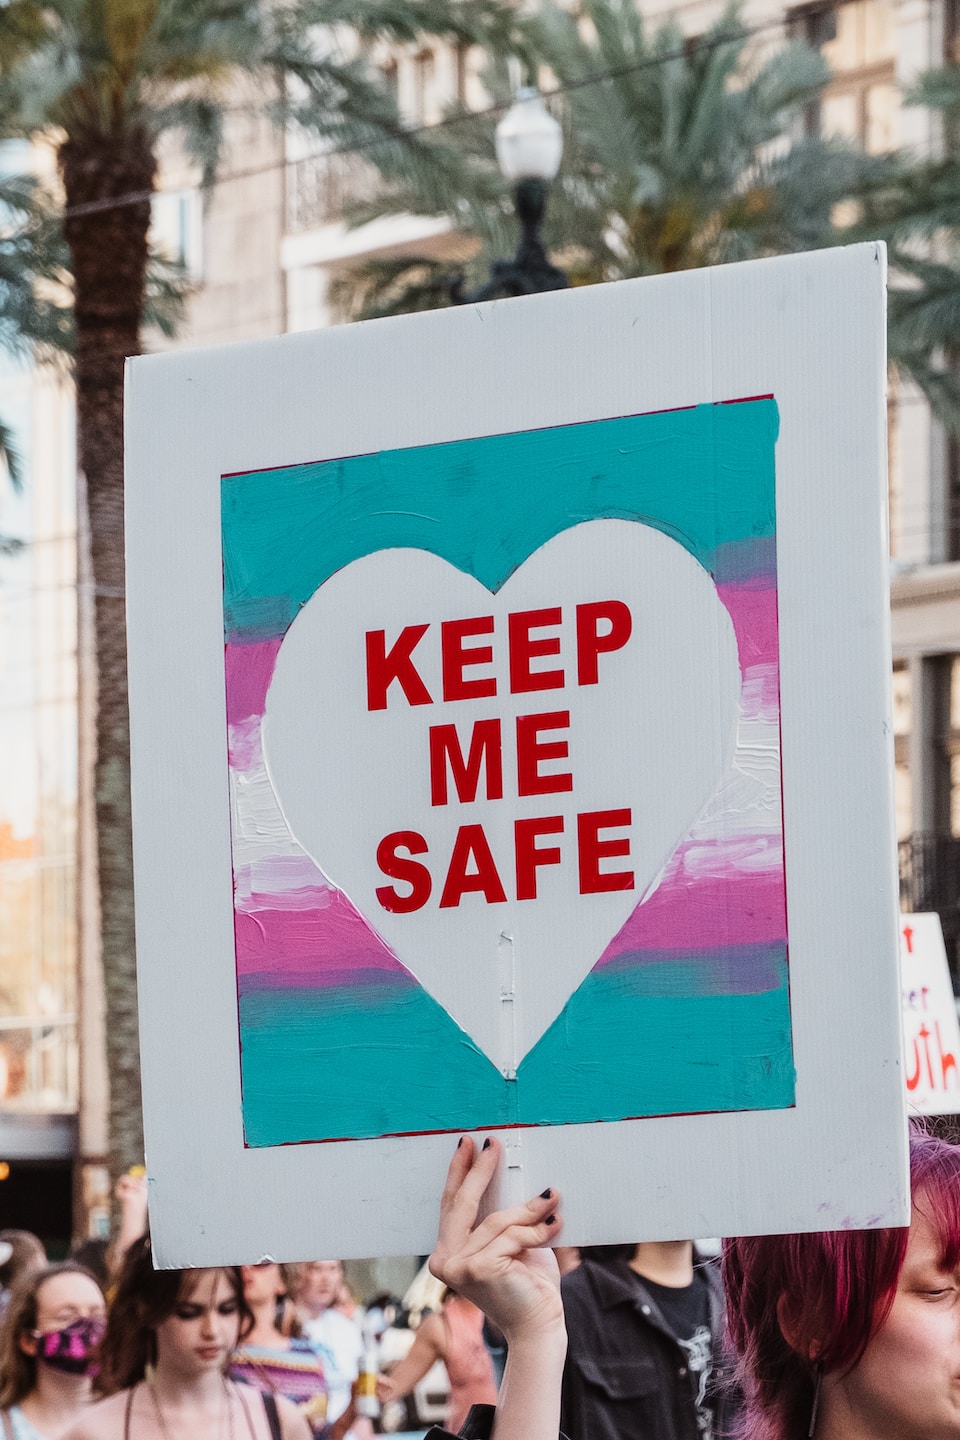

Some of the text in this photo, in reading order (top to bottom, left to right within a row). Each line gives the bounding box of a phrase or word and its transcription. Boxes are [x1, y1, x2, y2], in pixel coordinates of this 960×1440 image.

[365, 599, 633, 712] KEEP
[429, 709, 574, 807] ME
[375, 807, 636, 914] SAFE
